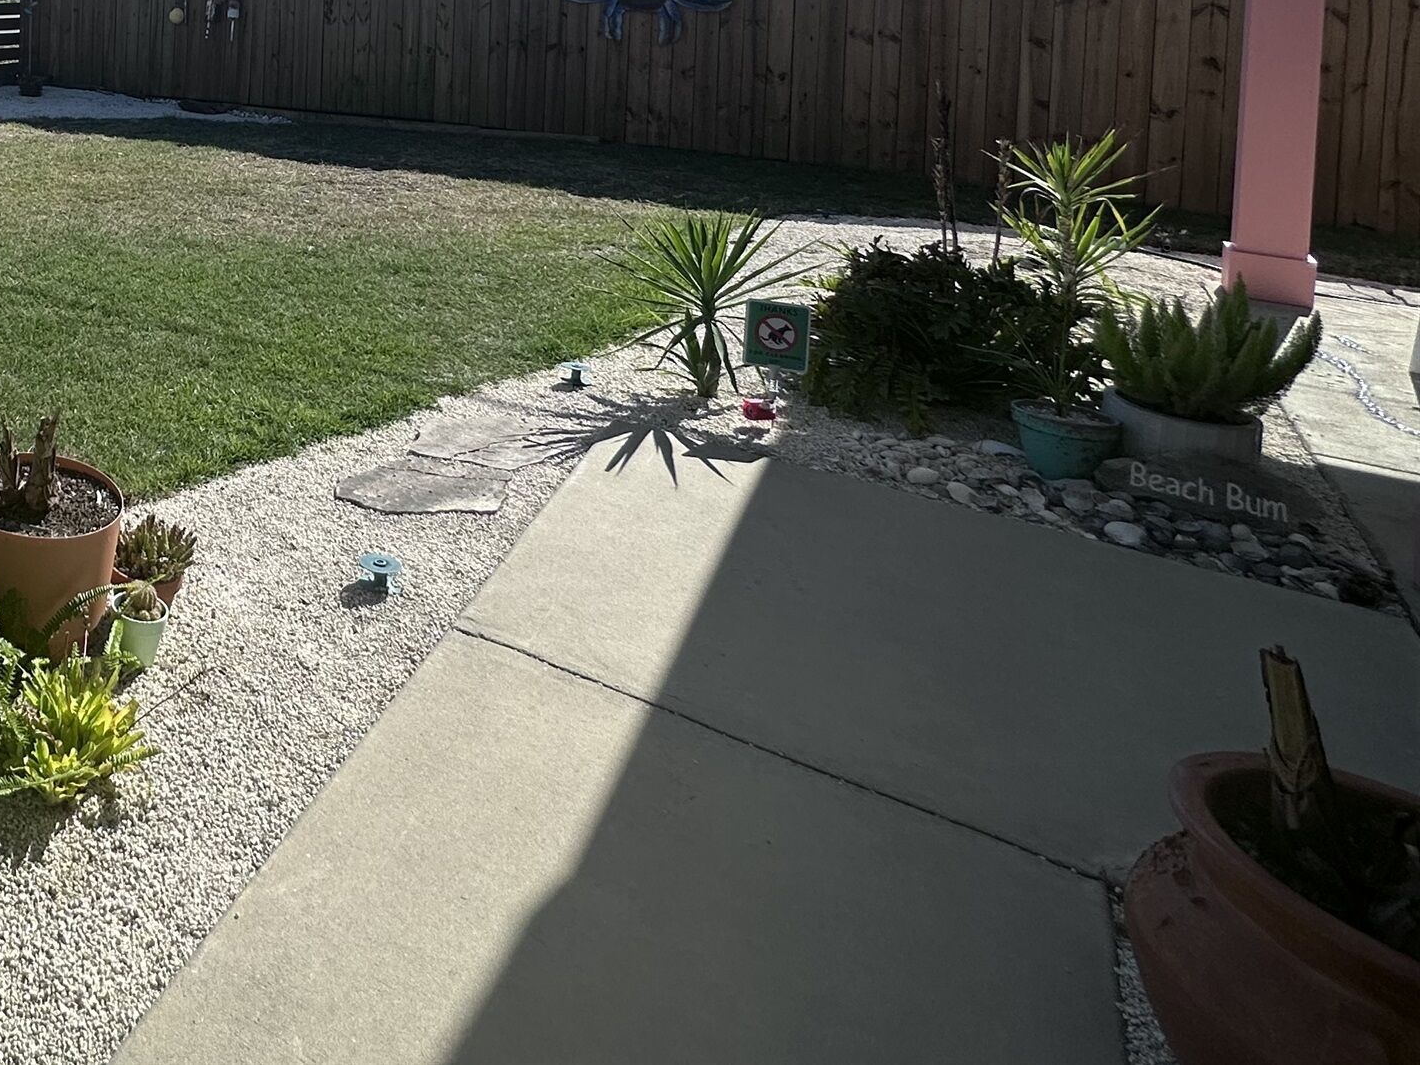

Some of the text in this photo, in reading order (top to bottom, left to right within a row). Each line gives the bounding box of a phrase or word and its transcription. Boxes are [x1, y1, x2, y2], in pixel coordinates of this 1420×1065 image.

[759, 304, 798, 317] THANKS
[1130, 461, 1288, 523] Beach Bum
